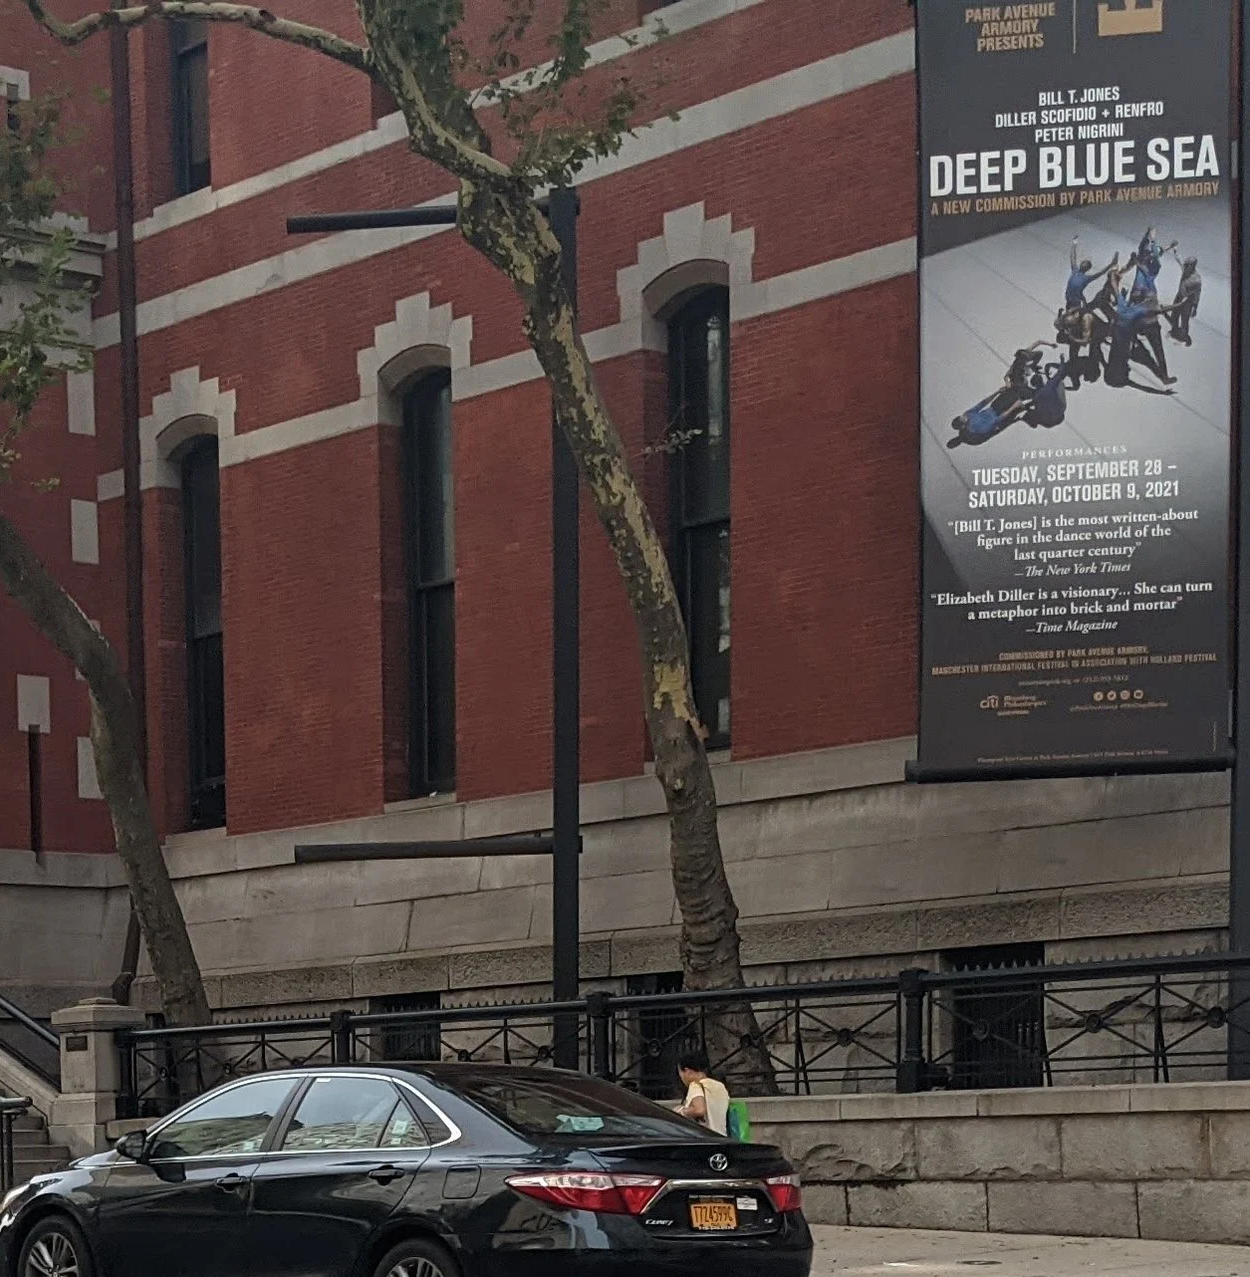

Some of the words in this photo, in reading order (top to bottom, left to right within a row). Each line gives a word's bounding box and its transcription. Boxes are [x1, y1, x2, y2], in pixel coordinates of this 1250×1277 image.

[965, 7, 1001, 23] PARK
[1003, 2, 1055, 20] AVENUE
[981, 19, 1039, 36] ARMORY
[977, 33, 1044, 52] PRESENTS
[1038, 91, 1064, 106] BILL
[1068, 89, 1079, 104] T.
[1080, 86, 1121, 103] JONES
[995, 111, 1037, 128] DILLER
[1040, 106, 1097, 125] SCOFIDIO
[1101, 109, 1110, 118] +
[1115, 101, 1164, 119] RENFRO
[1035, 127, 1074, 143] PETER
[1078, 122, 1124, 139] NIGRINI
[929, 149, 1027, 197] DEEP
[1039, 140, 1135, 189] BLUE
[1146, 134, 1220, 182] SEA
[931, 204, 939, 216] A
[943, 200, 970, 215] NEW
[975, 195, 1055, 213] COMMISSION
[1060, 192, 1075, 206] BY
[1080, 188, 1112, 206] PARK
[1116, 185, 1163, 202] AVENUE
[1166, 181, 1220, 198] ARMORY
[1021, 445, 1127, 460] PERFORMANCES
[972, 465, 1042, 486] TUESDAY,
[1046, 459, 1139, 482] SEPTEMBER
[1144, 459, 1162, 476] 28
[968, 487, 1048, 509] SATURDAY,
[1052, 483, 1121, 503] OCTOBER
[1127, 483, 1140, 500] 9,
[1145, 480, 1179, 497] 2021
[983, 519, 996, 531] T.
[997, 516, 1037, 533] Jones]
[1041, 516, 1052, 528] is
[1055, 514, 1075, 527] the
[1077, 515, 1109, 526] most
[1111, 507, 1199, 523] written-about
[977, 533, 1013, 550] figure
[1016, 533, 1029, 544] in
[1032, 530, 1052, 543] the
[1055, 529, 1092, 542] dance
[1095, 526, 1131, 539] world
[1134, 524, 1150, 537] of
[1151, 523, 1171, 537] the
[1014, 548, 1036, 561] last
[1038, 548, 1085, 563] quarter
[1045, 564, 1071, 576] New
[1073, 562, 1098, 574] York
[1100, 561, 1131, 573] Times
[930, 590, 994, 606] “Elizabeth
[998, 588, 1036, 602] Diller
[1038, 588, 1048, 600] is
[1051, 590, 1058, 599] a
[1061, 586, 1131, 599] visionary...
[1133, 581, 1158, 595] She
[1160, 584, 1182, 593] can
[1185, 582, 1213, 592] turn
[967, 611, 976, 620] a
[978, 604, 1039, 621] metaphor
[1041, 604, 1067, 616] into
[1070, 600, 1103, 614] brick
[1106, 599, 1130, 613] and
[1065, 619, 1118, 634] Magazine
[1067, 648, 1086, 657] PARK
[931, 664, 979, 676] MANCHESTER
[981, 662, 1035, 673] INTERNATIONAL
[1037, 660, 1069, 670] FESTIVAL
[1184, 653, 1218, 663] FESTIVAL
